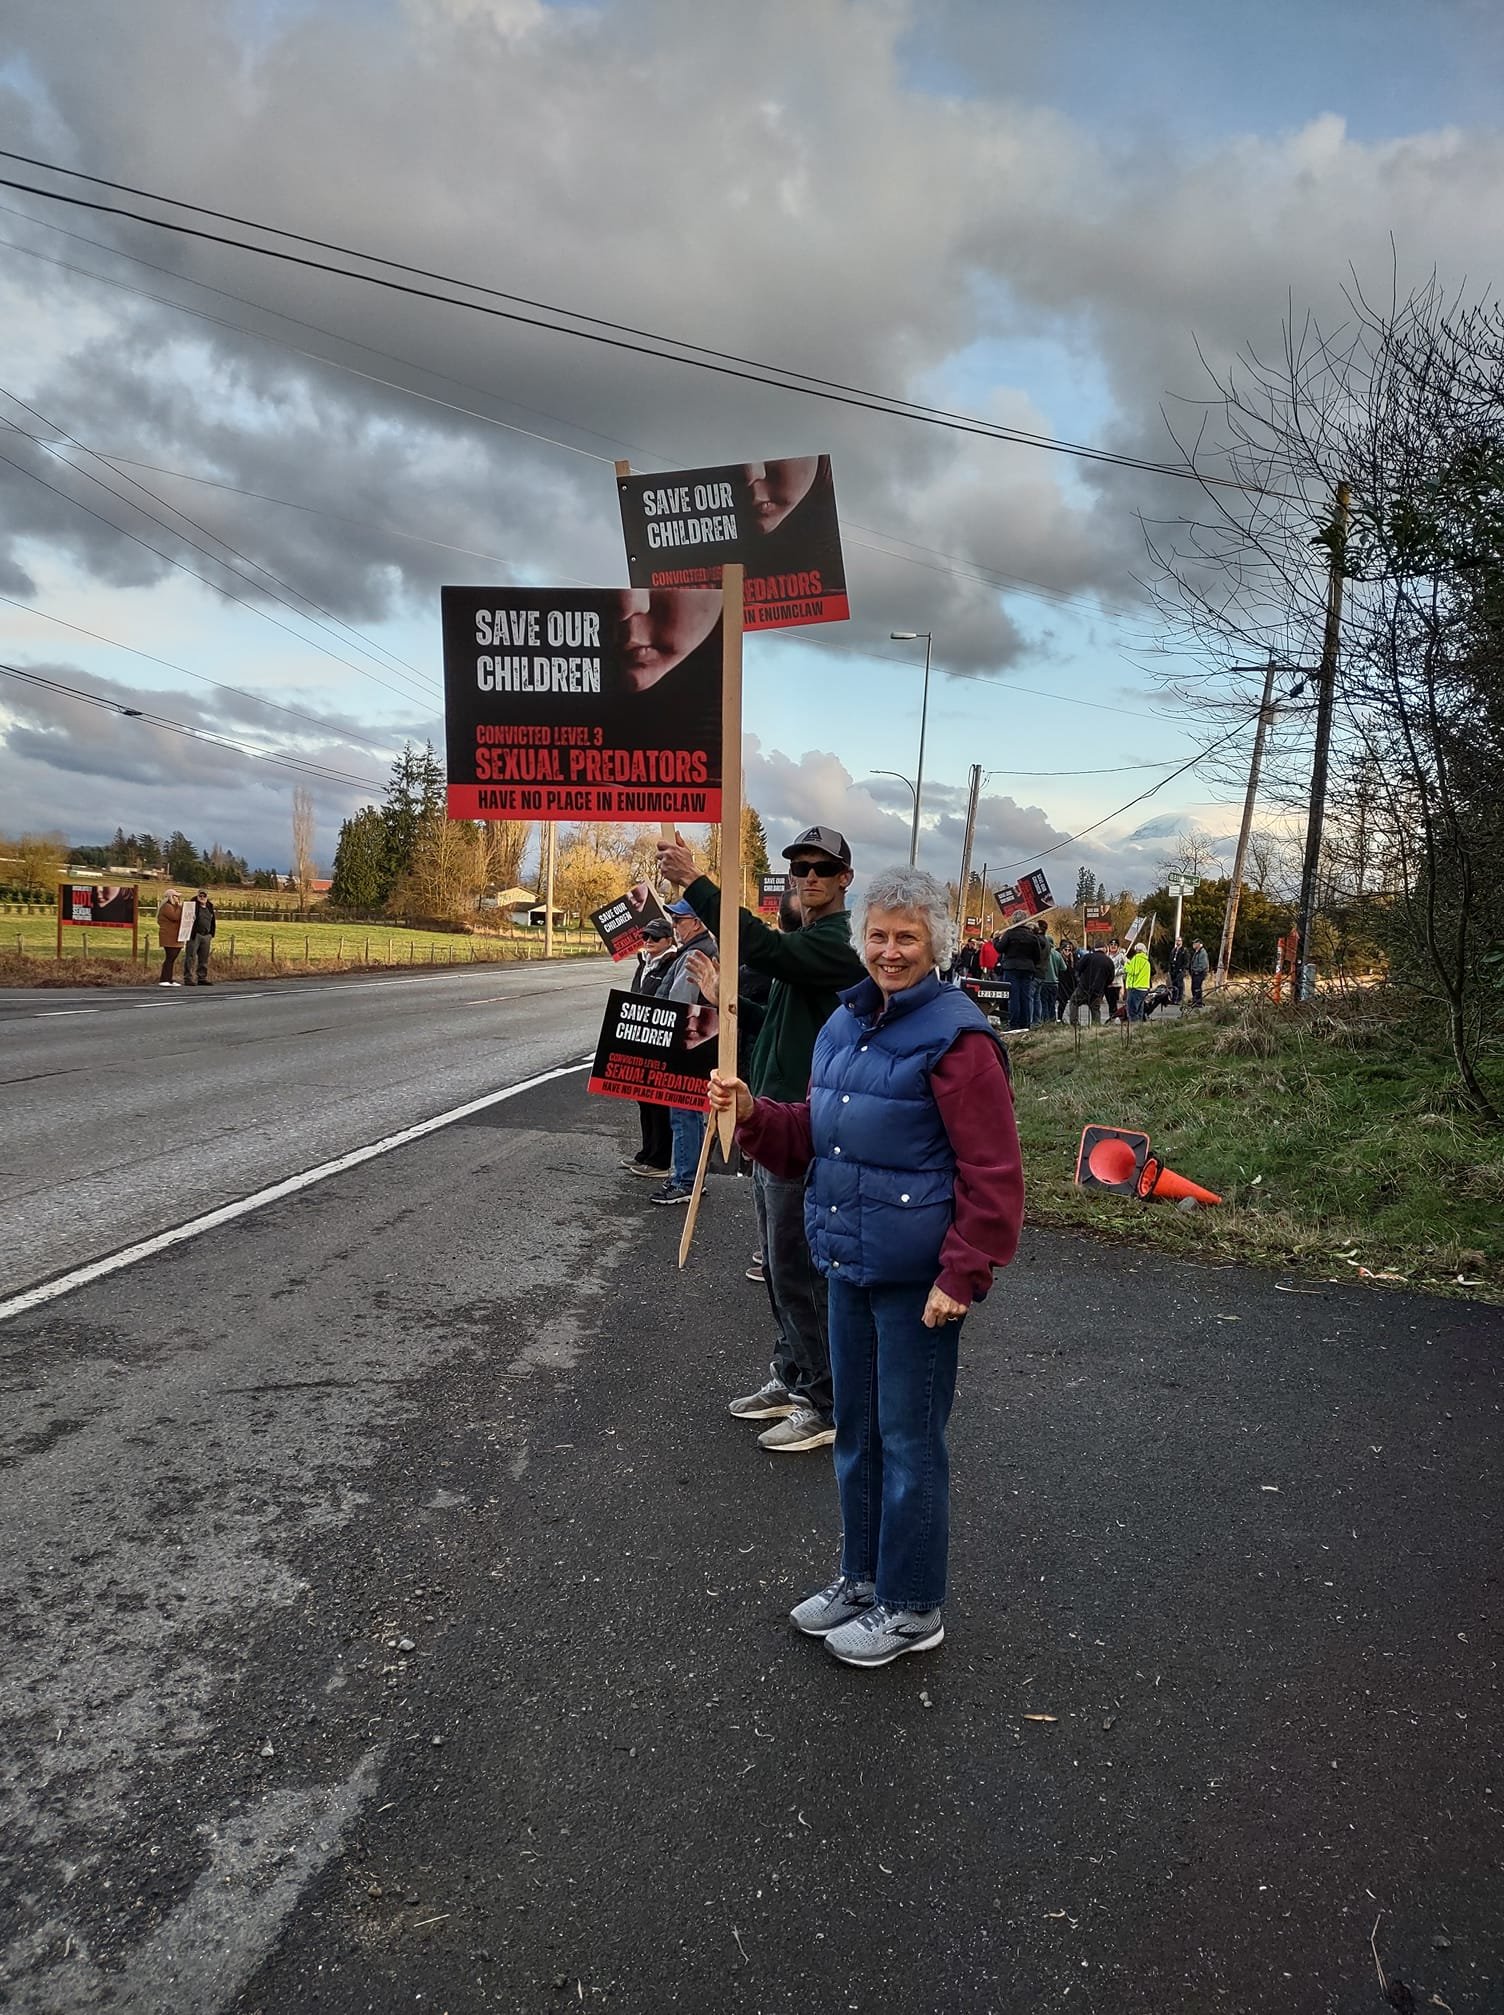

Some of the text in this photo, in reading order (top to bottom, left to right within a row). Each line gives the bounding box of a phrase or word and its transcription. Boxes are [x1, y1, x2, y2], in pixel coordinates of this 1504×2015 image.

[643, 482, 734, 516] SAVE OUR
[647, 514, 738, 548] CHILDREN
[652, 568, 706, 587] CONVICTED
[759, 601, 823, 624] ENUMCLAW
[475, 609, 600, 647] SAVE OUR
[477, 656, 600, 692] CHILDREN
[476, 725, 603, 746] CONVICTED LEVEL 3
[475, 748, 708, 783] SEXUAL PREDATORS
[478, 790, 706, 813] HAVE NO PLACE IN ENUMCLAW
[598, 902, 628, 924] SAVE OUR
[603, 911, 633, 933] CHILDREN
[620, 1002, 677, 1028] SAVE OUR
[616, 1022, 673, 1047] CHILDREN
[609, 1052, 667, 1071] CONVICTED LEVEL 3
[605, 1062, 709, 1094] SEXUAL PREDATORS
[602, 1081, 706, 1107] HAVE NO PLACE IN ENUMCLAW
